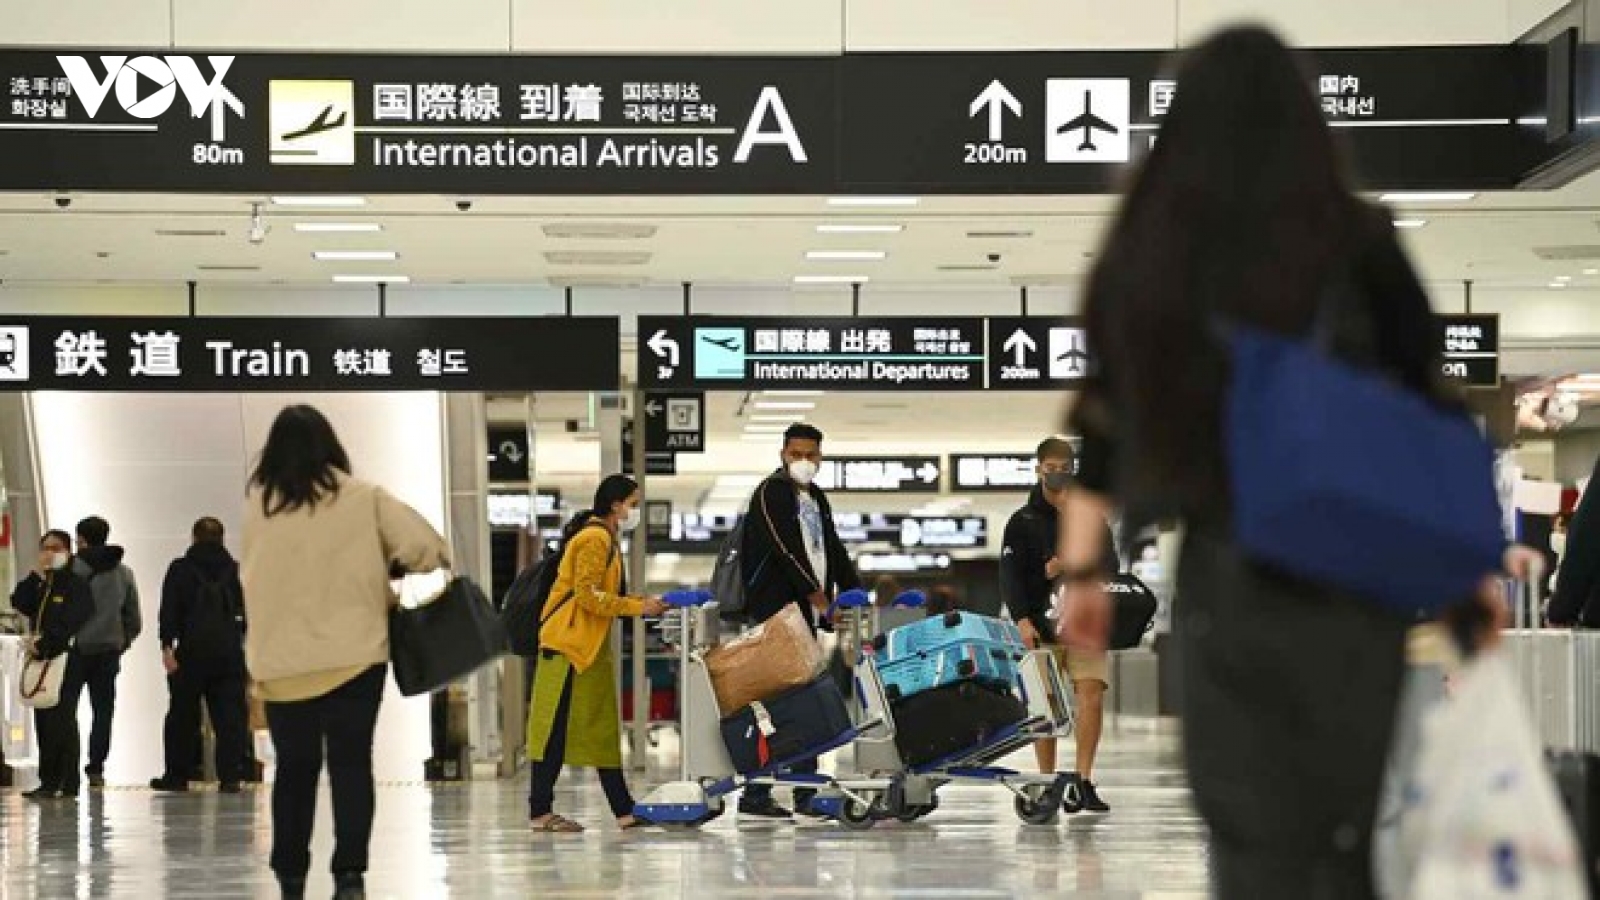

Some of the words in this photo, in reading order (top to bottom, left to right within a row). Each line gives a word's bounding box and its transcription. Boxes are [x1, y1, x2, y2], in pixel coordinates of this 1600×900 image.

[11, 99, 66, 117] 화장실
[373, 83, 501, 121] 国際線
[521, 83, 604, 121] 到着
[623, 104, 675, 123] 국제선
[681, 104, 717, 123] 도착
[733, 86, 807, 163] A
[193, 144, 243, 164] 80m
[374, 137, 587, 167] International
[596, 137, 718, 167] Arrivals
[965, 144, 1026, 163] 200m
[206, 342, 308, 376] Train
[417, 349, 468, 376] 철도
[754, 361, 868, 379] International
[872, 362, 970, 384] Departures
